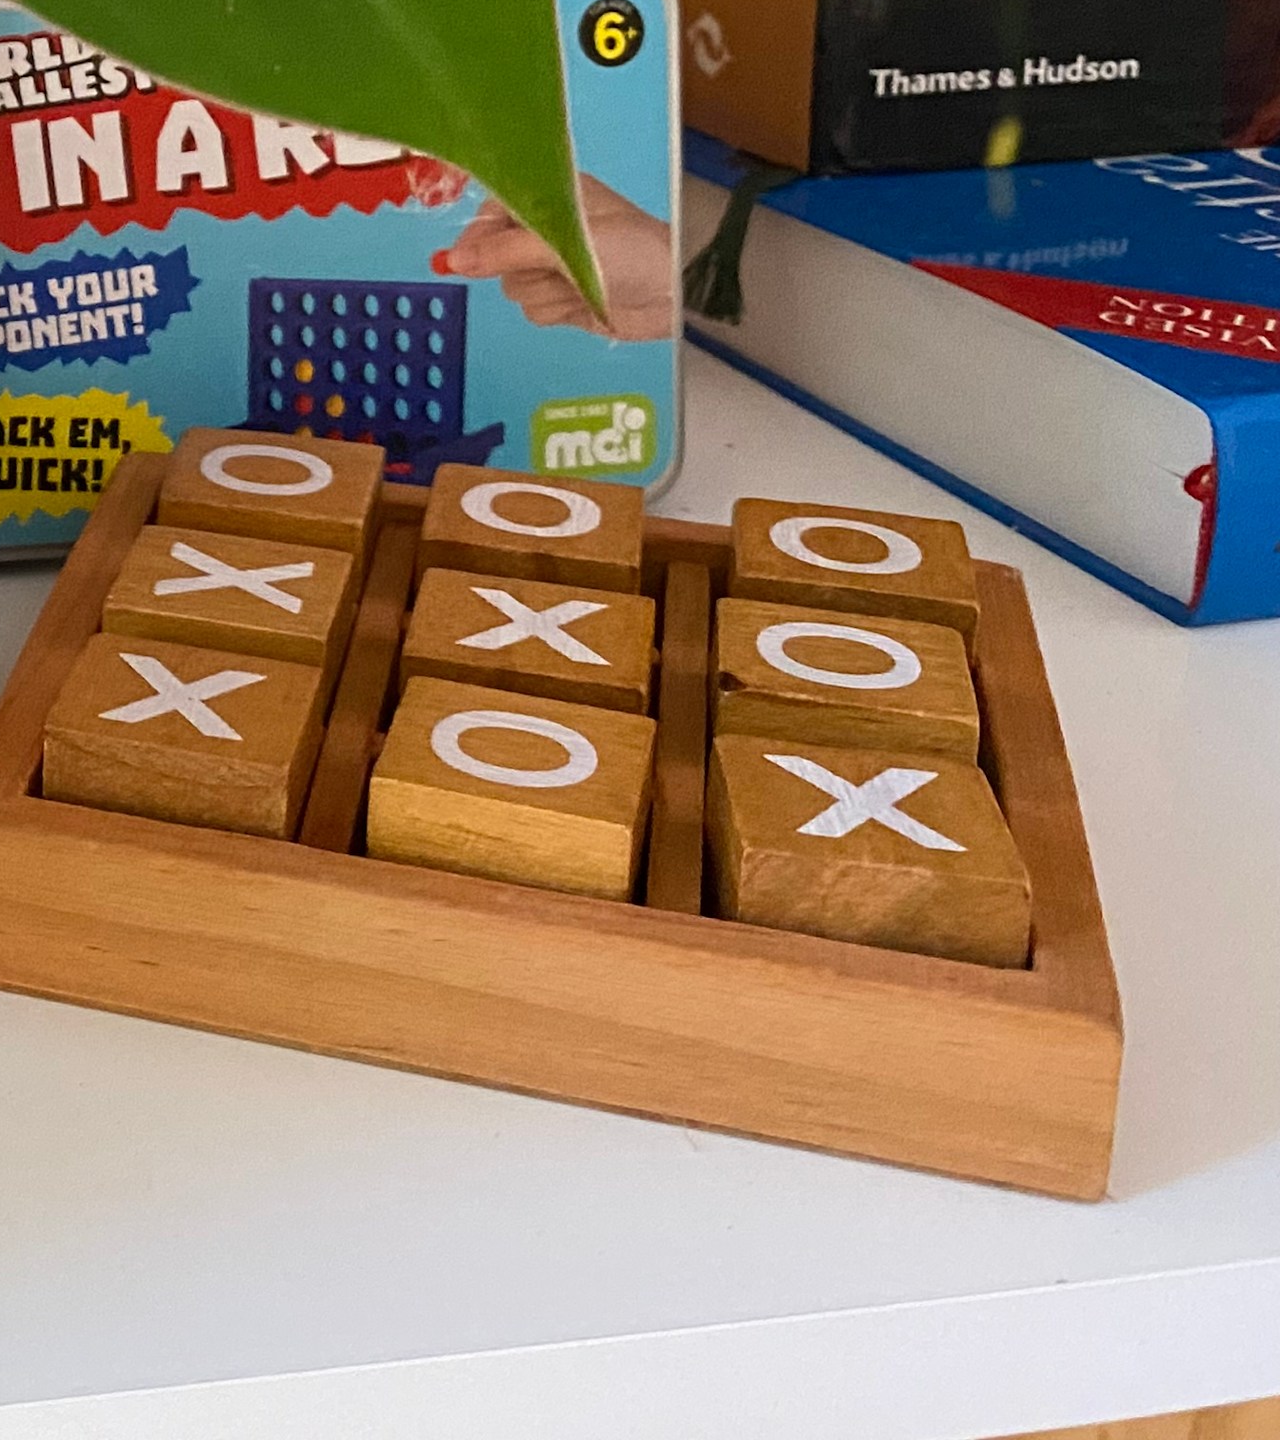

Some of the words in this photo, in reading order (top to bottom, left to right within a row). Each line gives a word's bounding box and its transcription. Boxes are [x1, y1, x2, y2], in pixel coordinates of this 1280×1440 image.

[869, 67, 991, 97] Thames
[997, 67, 1017, 88] &
[1023, 54, 1140, 86] Hudson
[10, 109, 130, 213] IN
[155, 98, 230, 192] A
[46, 264, 159, 310] YOUR
